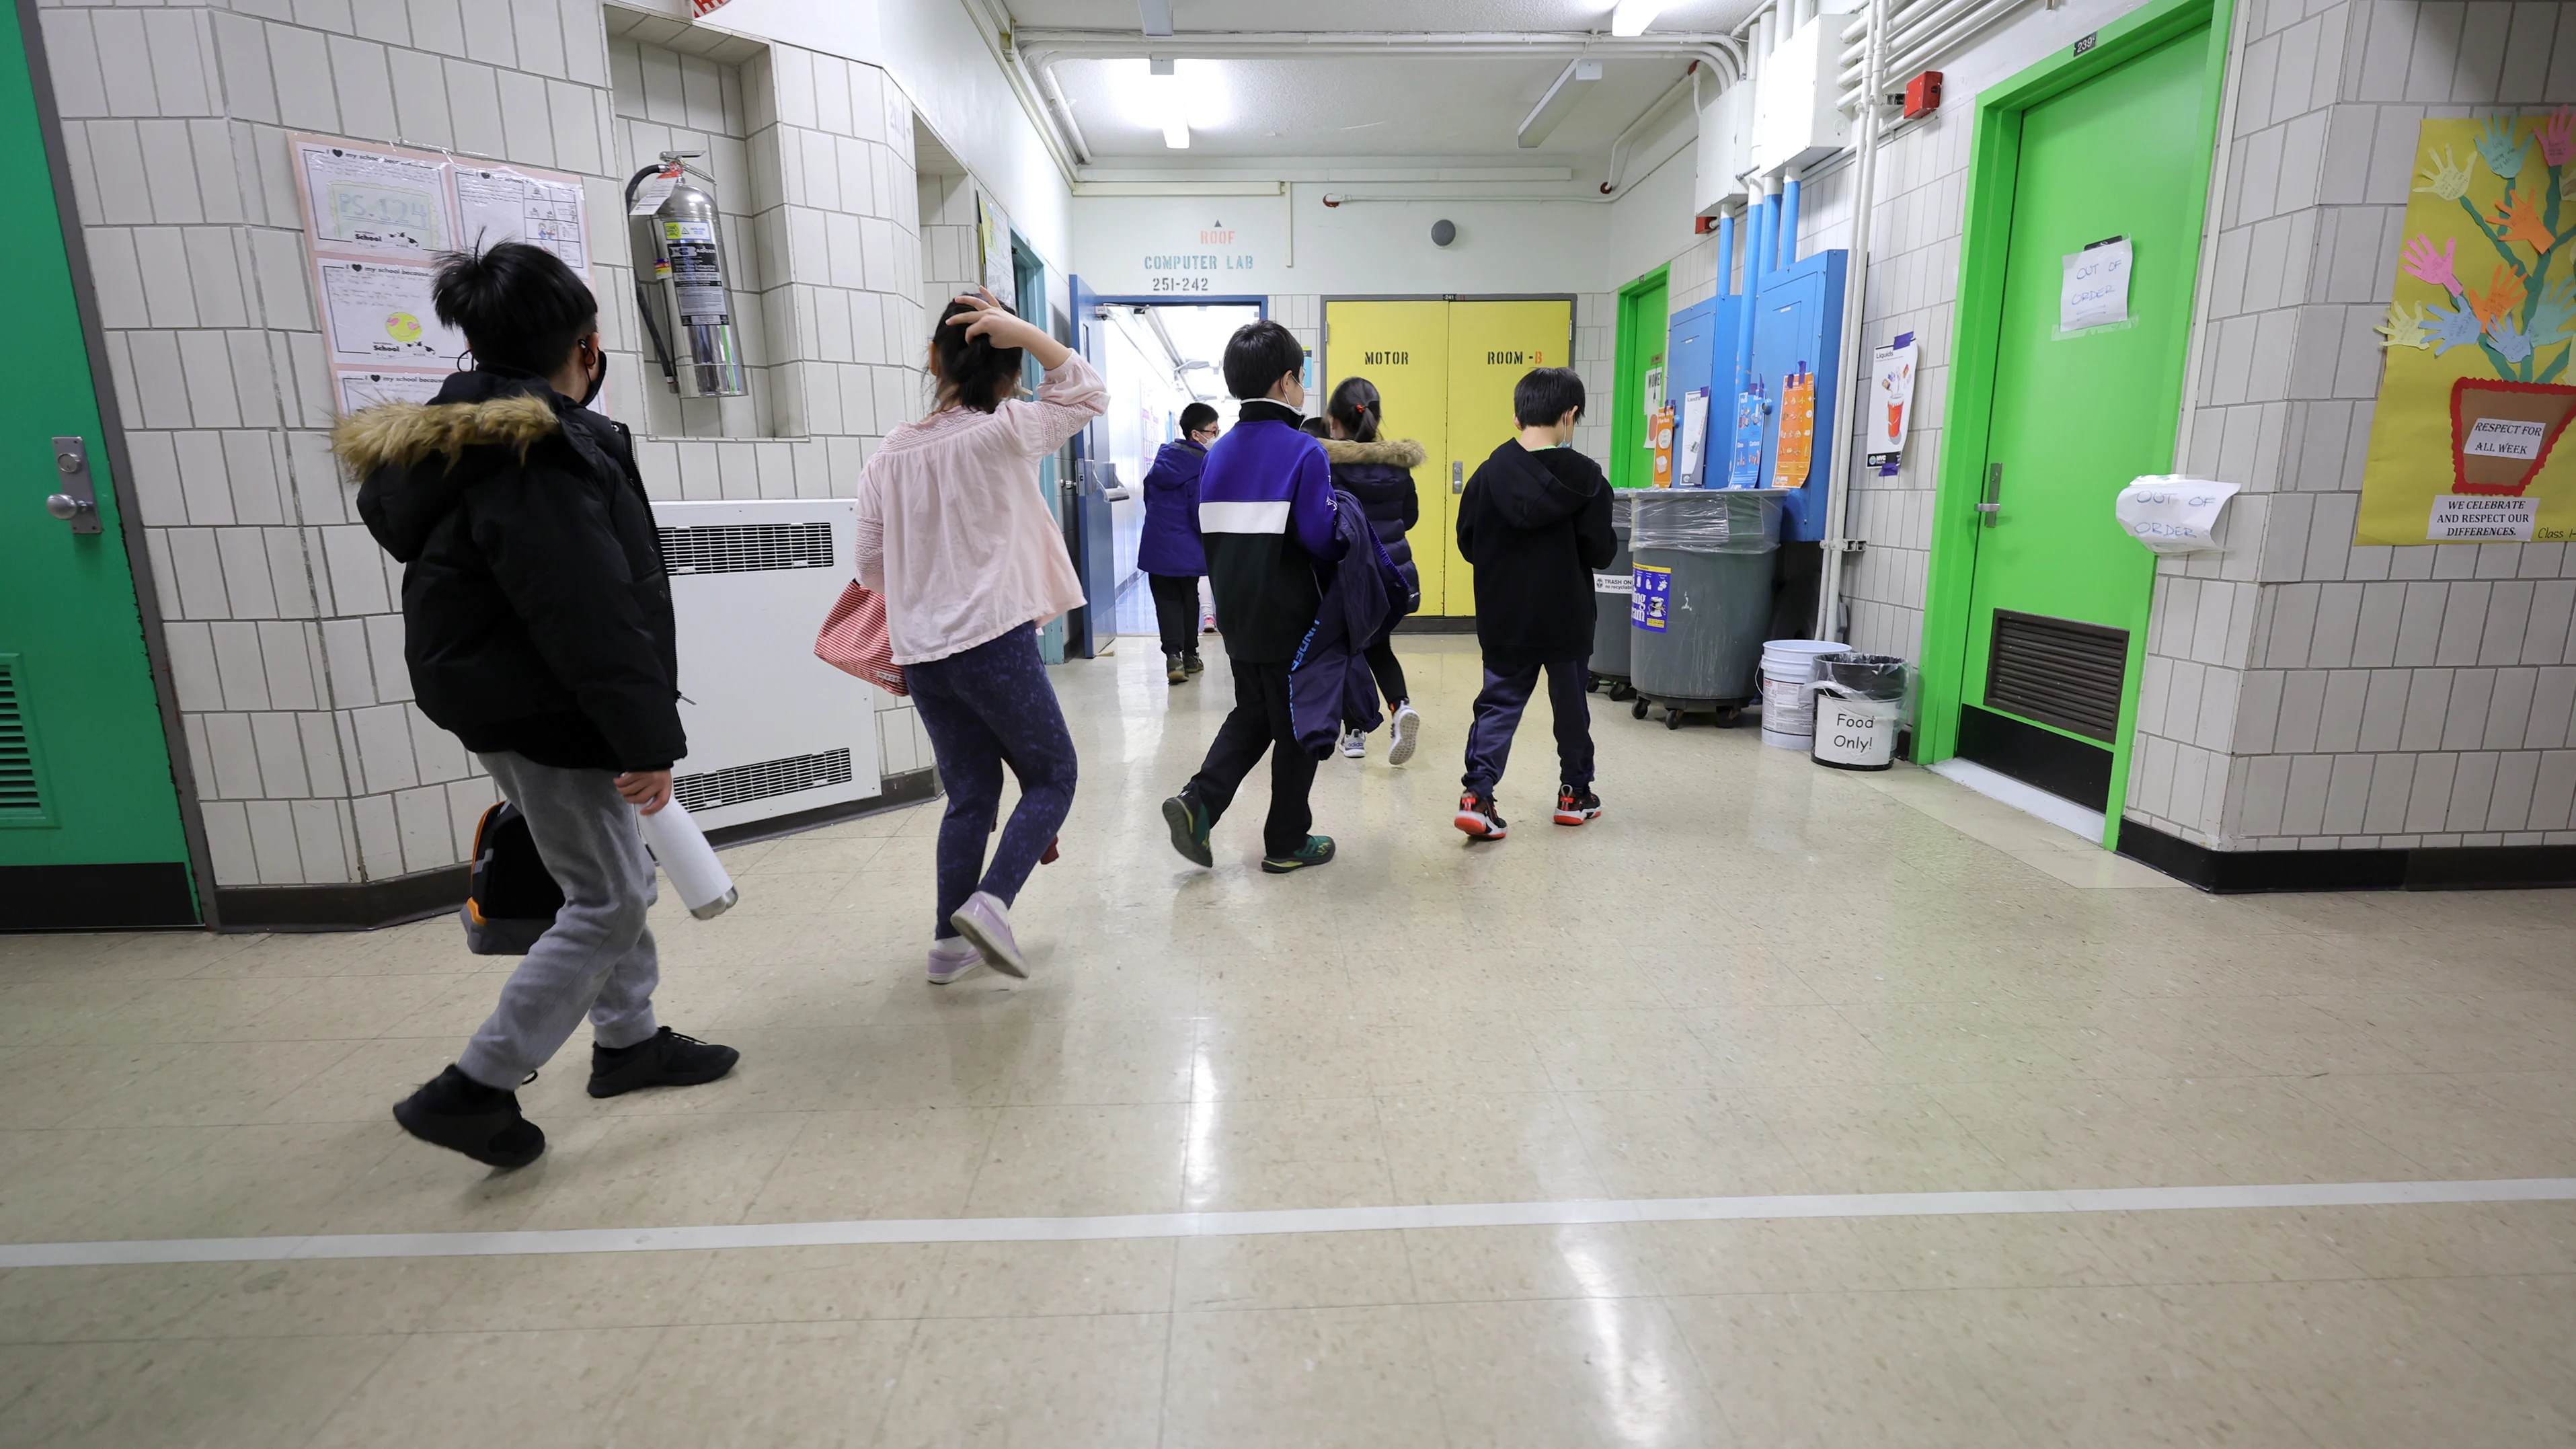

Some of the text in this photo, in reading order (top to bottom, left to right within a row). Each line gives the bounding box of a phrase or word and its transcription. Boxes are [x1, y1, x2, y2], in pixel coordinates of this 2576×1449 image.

[2077, 36, 2093, 53] 239
[1200, 231, 1235, 244] ROOF
[1144, 256, 1253, 270] COMPUTER LAB
[379, 267, 400, 275] school
[2076, 260, 2121, 280] OUT OF
[1153, 278, 1208, 291] 251-242
[2072, 285, 2115, 305] ORDER
[1365, 352, 1409, 364] MOTOR
[1487, 351, 1523, 364] ROOM
[1876, 350, 1894, 360] Liquids
[2474, 422, 2542, 436] RESPECT FOR
[2474, 442, 2528, 455] ALL WEEK
[2137, 490, 2216, 507] OUT OF
[2448, 501, 2526, 510] WE CELEBRATE
[2437, 514, 2529, 523] AND RESPECT OUR
[2134, 522, 2197, 538] ORDER
[2447, 527, 2516, 537] DIFFERENCES.
[2538, 527, 2563, 539] Class
[1836, 713, 1875, 728] Food
[1834, 735, 1873, 753] Only!
